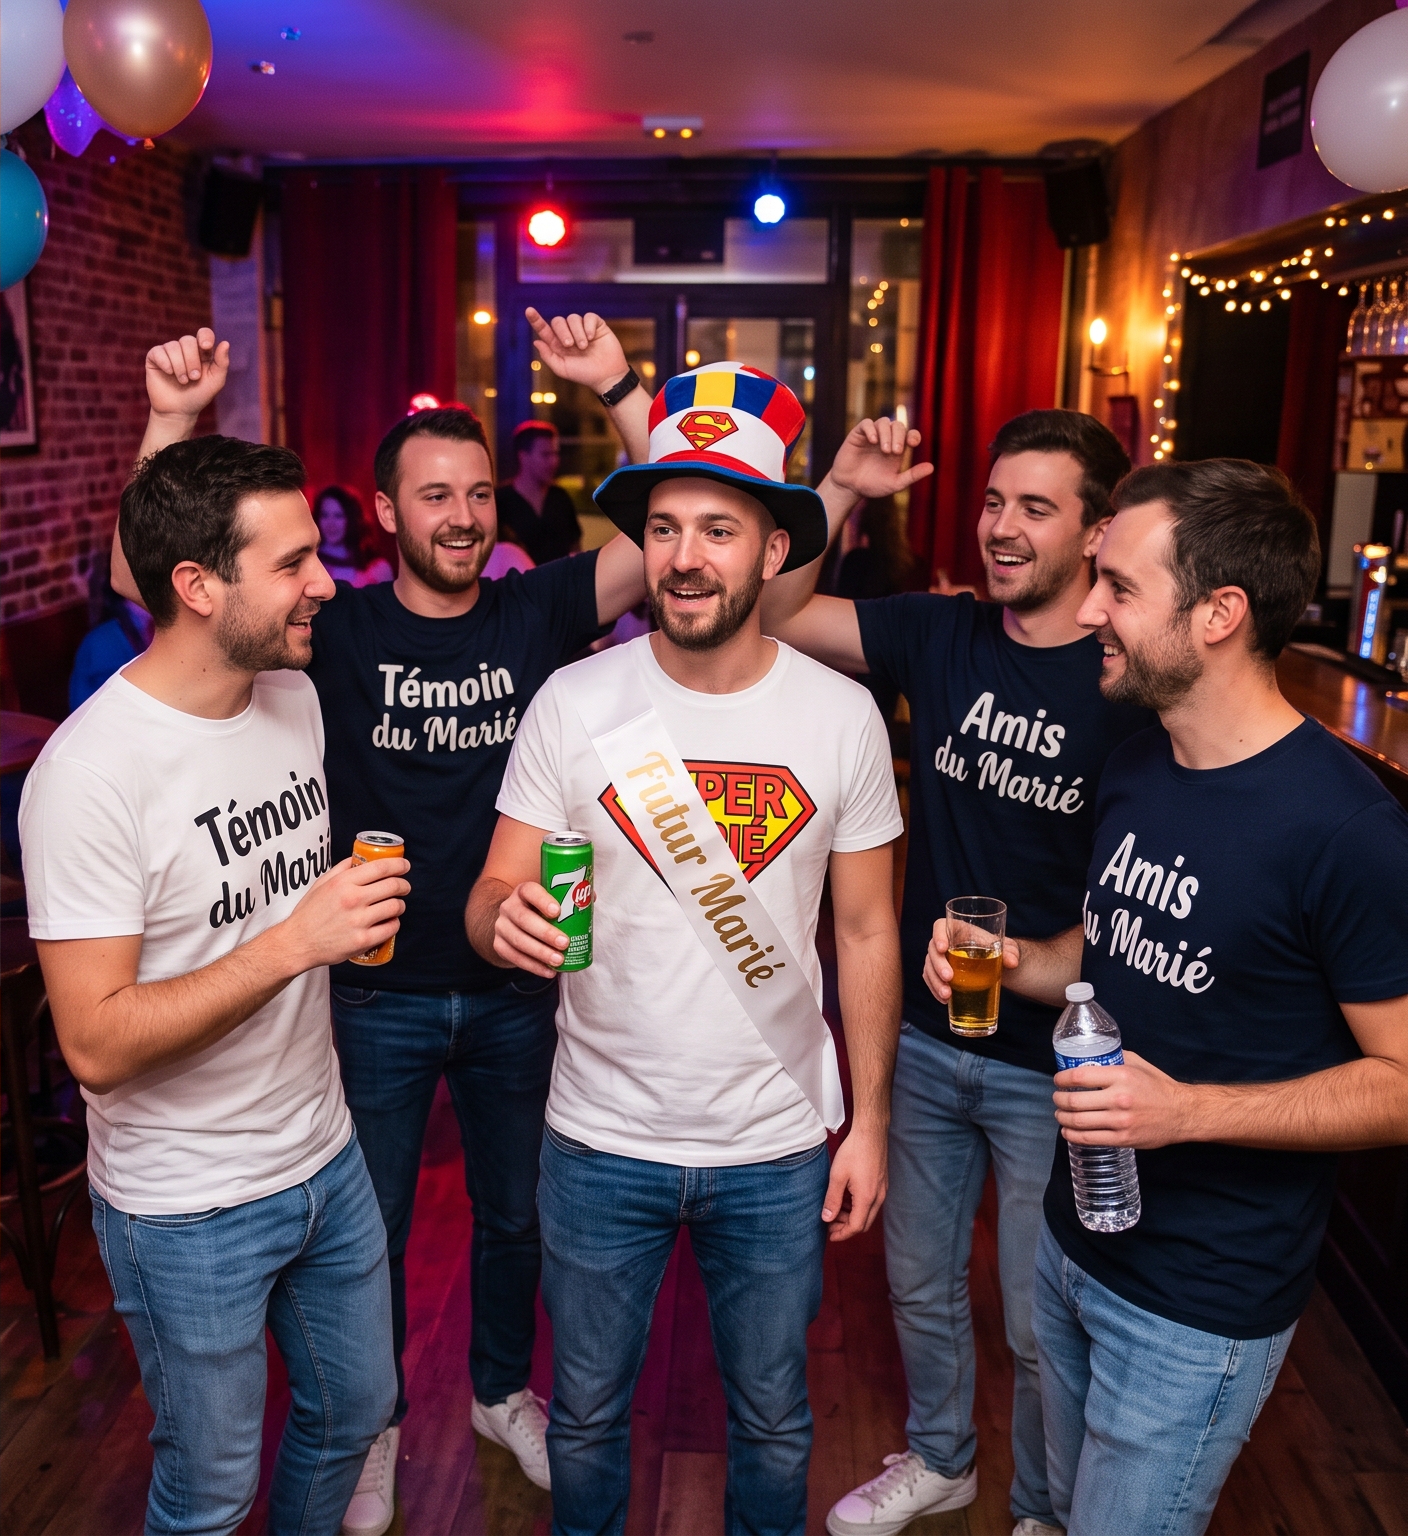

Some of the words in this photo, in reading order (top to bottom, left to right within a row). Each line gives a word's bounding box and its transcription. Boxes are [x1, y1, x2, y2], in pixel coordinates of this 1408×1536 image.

[378, 662, 515, 708] Témoin
[371, 713, 417, 751] du
[422, 706, 518, 753] Marié
[959, 691, 1066, 758] Amis
[695, 771, 789, 820] PER
[934, 735, 968, 782] du
[977, 750, 1085, 815] Marié
[193, 770, 327, 867] Témoin
[209, 881, 256, 929] du
[625, 751, 707, 866] Futur
[690, 873, 786, 989] Marié
[1099, 832, 1199, 919] Amis
[1109, 908, 1215, 994] Marié
